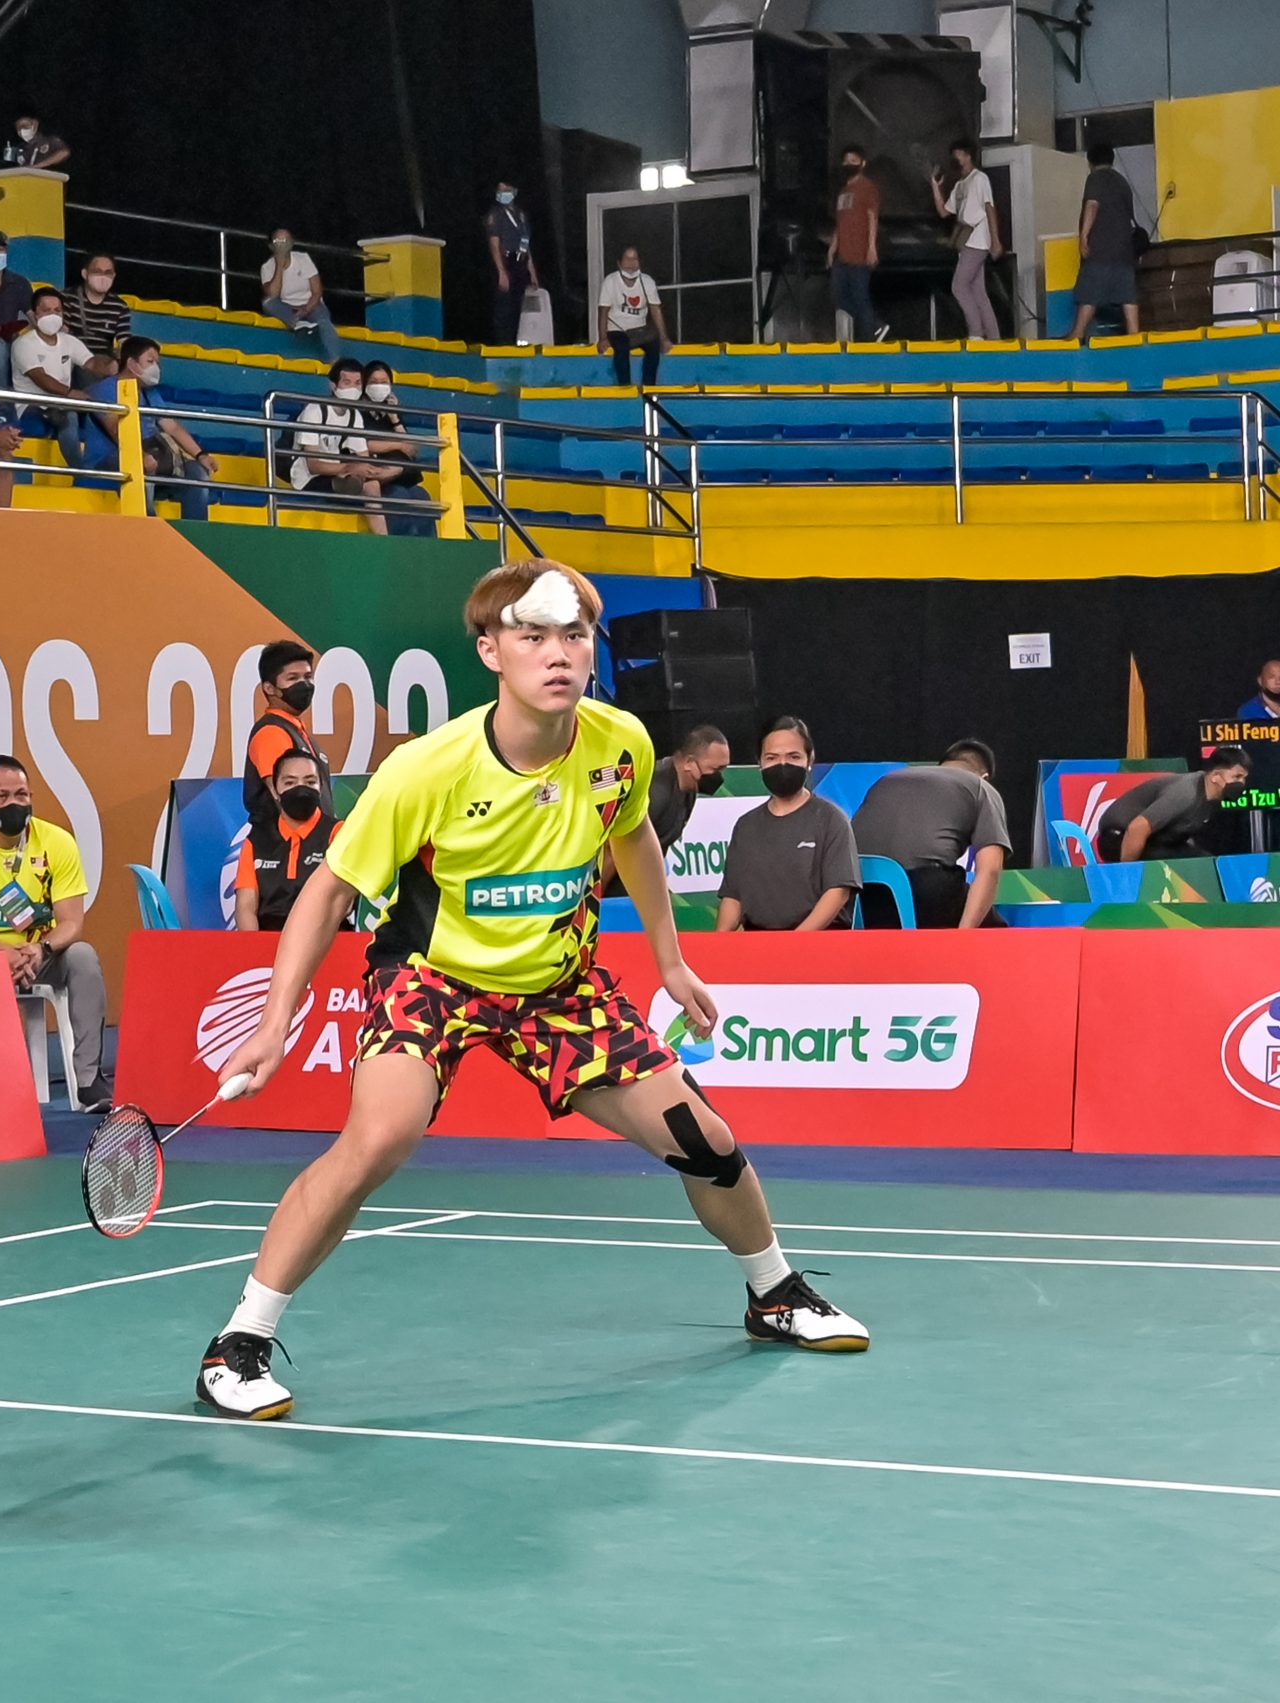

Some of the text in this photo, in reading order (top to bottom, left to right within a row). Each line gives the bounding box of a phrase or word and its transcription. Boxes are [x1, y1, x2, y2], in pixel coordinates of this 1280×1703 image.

[1019, 653, 1040, 664] EXIT
[1215, 723, 1239, 742] Shi
[1242, 723, 1280, 743] Feng
[1249, 789, 1276, 807] Tzu
[672, 840, 729, 877] Sma
[720, 1015, 958, 1063] Smart 5G
